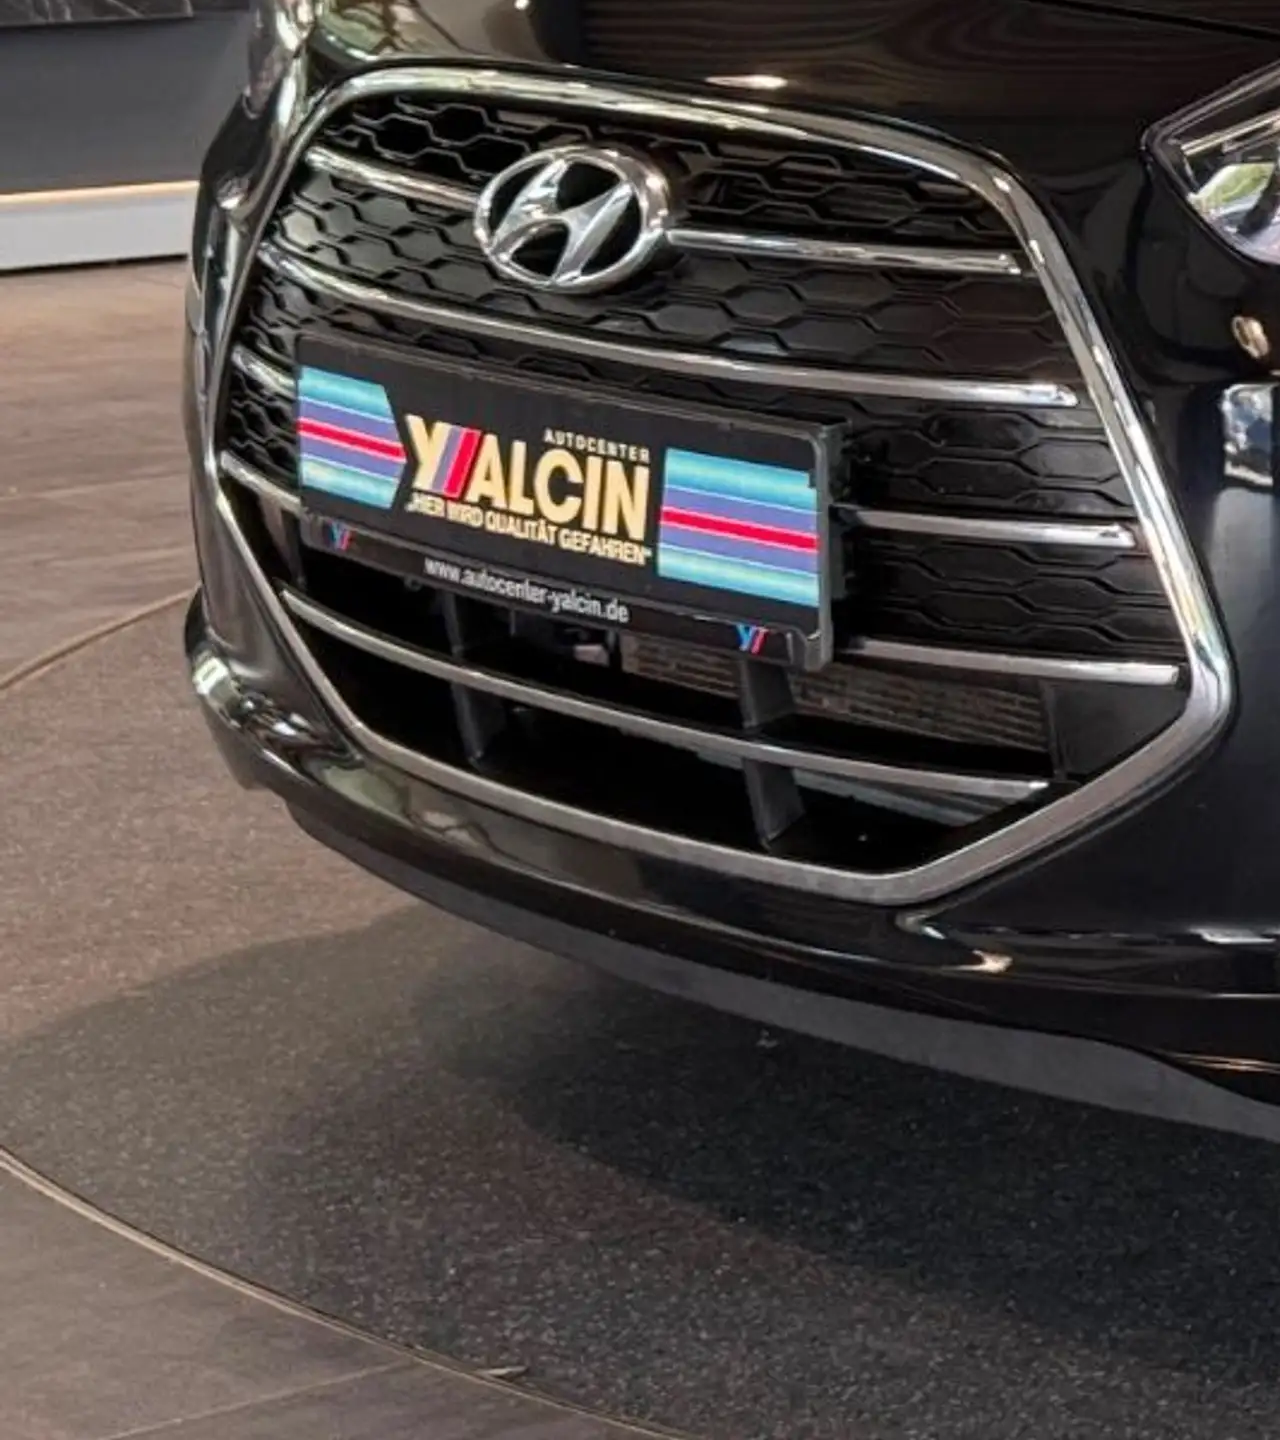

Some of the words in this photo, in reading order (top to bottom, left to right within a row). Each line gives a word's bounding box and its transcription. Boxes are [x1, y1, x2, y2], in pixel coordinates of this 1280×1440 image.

[544, 427, 650, 464] AUTOCENTER
[404, 414, 650, 541] YALCIN
[446, 500, 484, 528] WIRD
[484, 510, 557, 545] QUALITÄT
[424, 557, 630, 624] www.autocenter-yalcin.de
